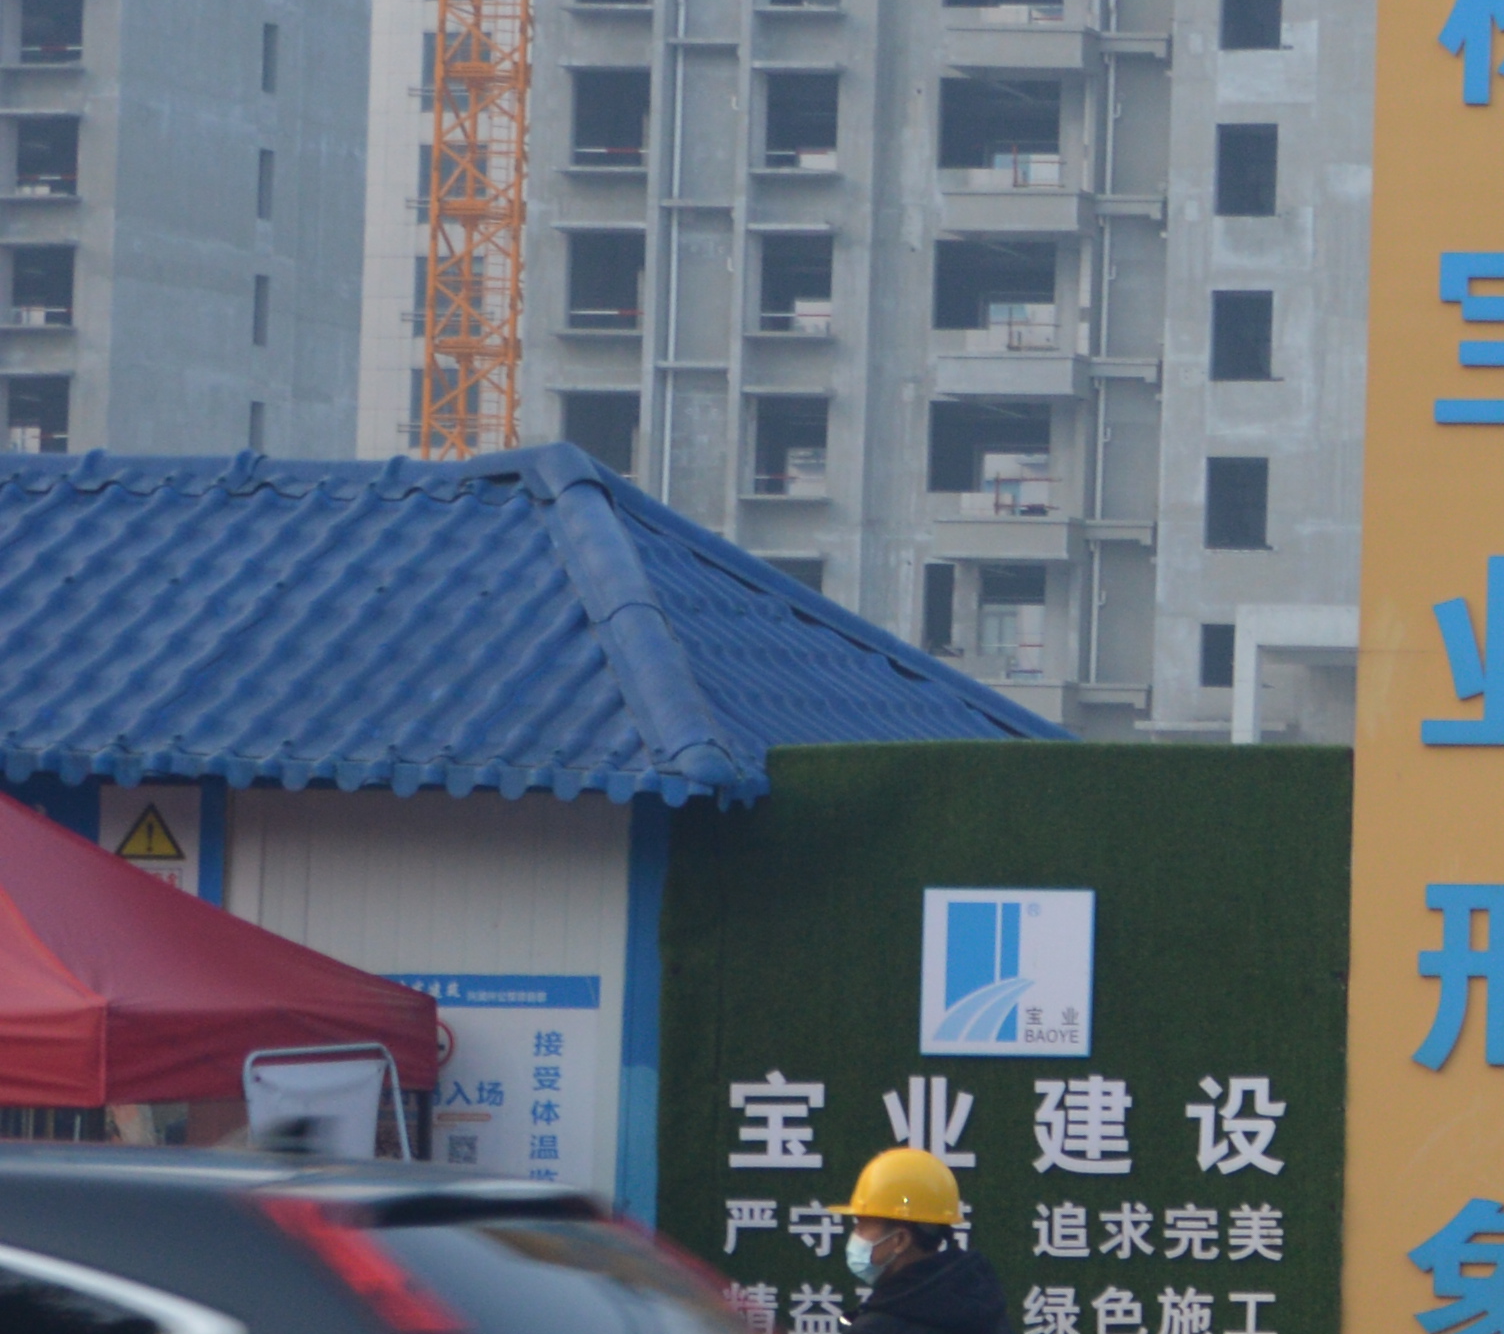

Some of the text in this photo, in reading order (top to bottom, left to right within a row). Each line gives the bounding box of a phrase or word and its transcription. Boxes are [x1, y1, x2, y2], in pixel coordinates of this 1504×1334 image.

[1025, 1006, 1080, 1026] 宝业
[1024, 1029, 1080, 1044] BAOYE
[728, 1069, 1287, 1176] 宝业建设
[1032, 1201, 1284, 1262] 追求完美
